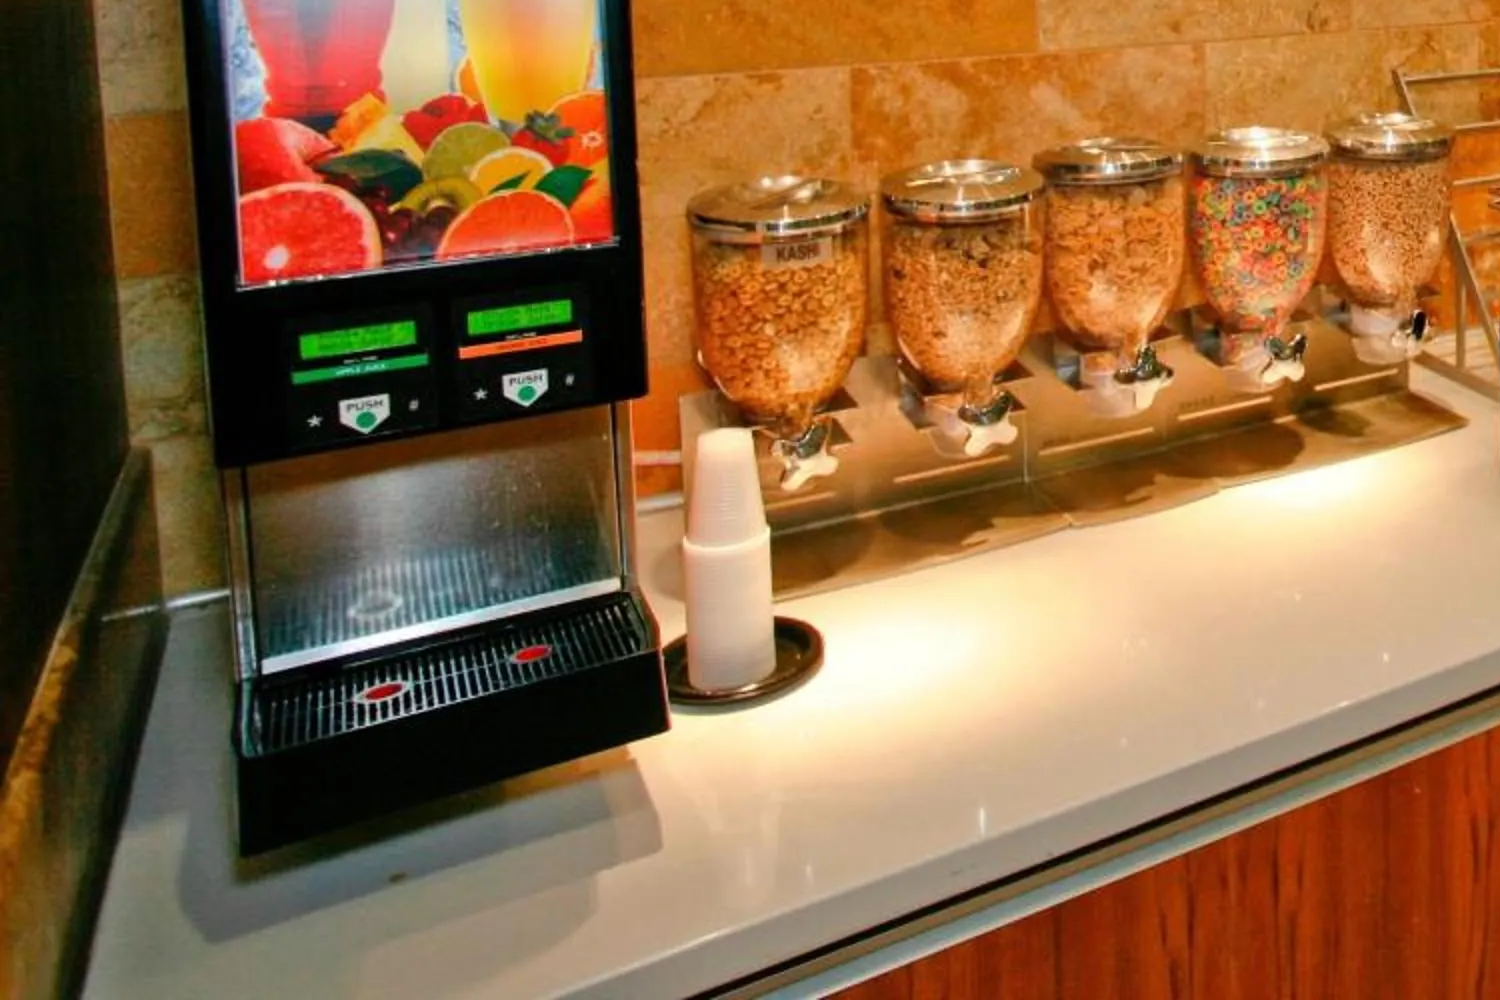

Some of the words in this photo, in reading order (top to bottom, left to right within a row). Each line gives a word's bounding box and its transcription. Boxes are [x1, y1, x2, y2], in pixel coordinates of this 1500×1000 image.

[776, 242, 820, 263] KASHI
[509, 373, 543, 386] PUSH
[346, 399, 383, 413] PUSH
